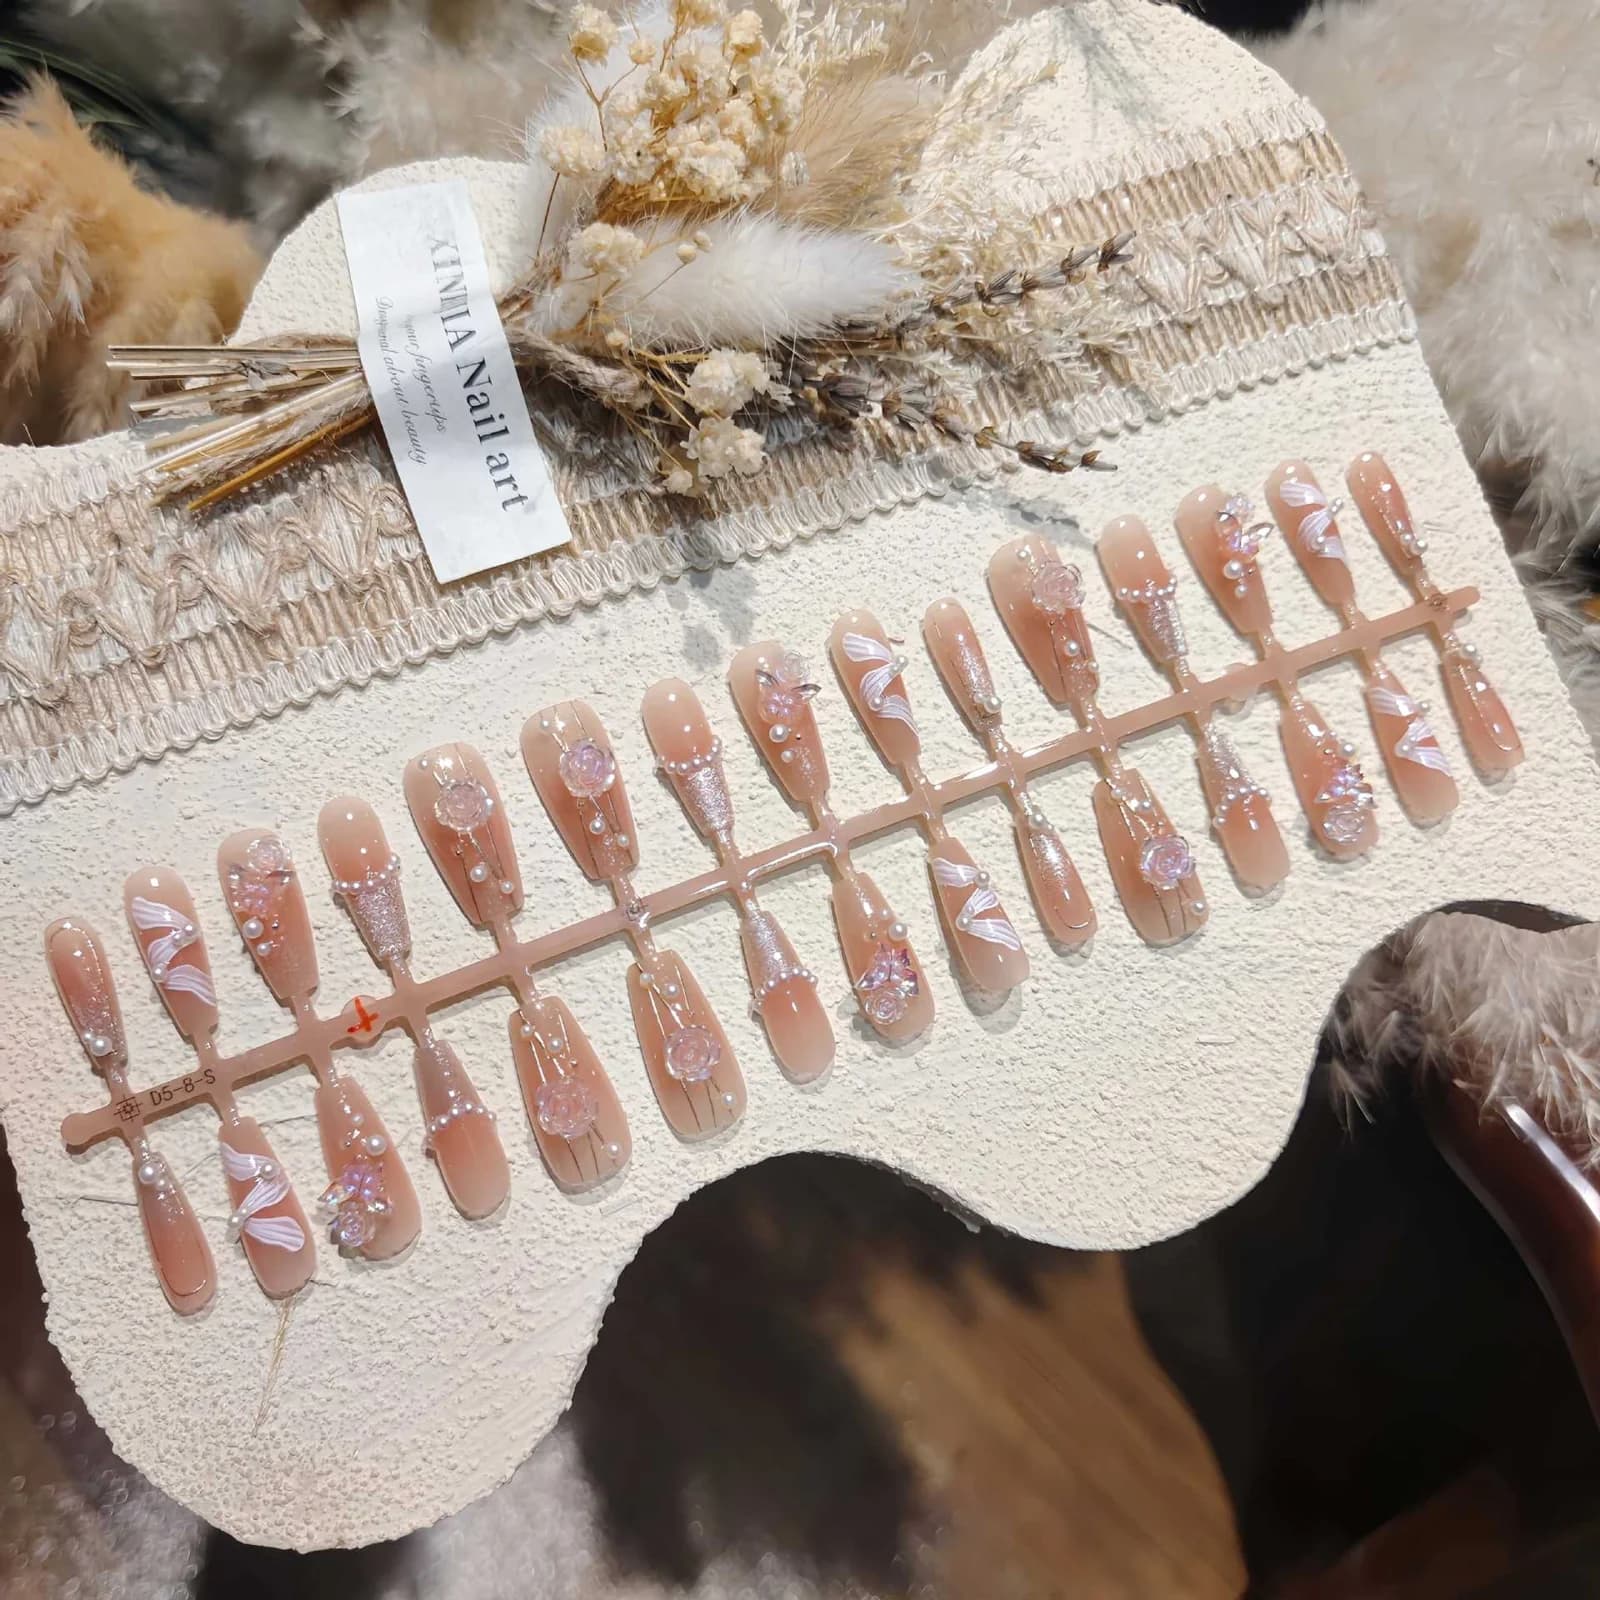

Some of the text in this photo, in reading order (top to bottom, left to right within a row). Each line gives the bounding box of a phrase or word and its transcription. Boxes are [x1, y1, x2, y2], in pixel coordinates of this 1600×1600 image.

[383, 353, 409, 407] about
[398, 405, 427, 465] beauty
[456, 356, 510, 444] Nail
[485, 453, 528, 511] art
[150, 1069, 216, 1106] D5-8-S
